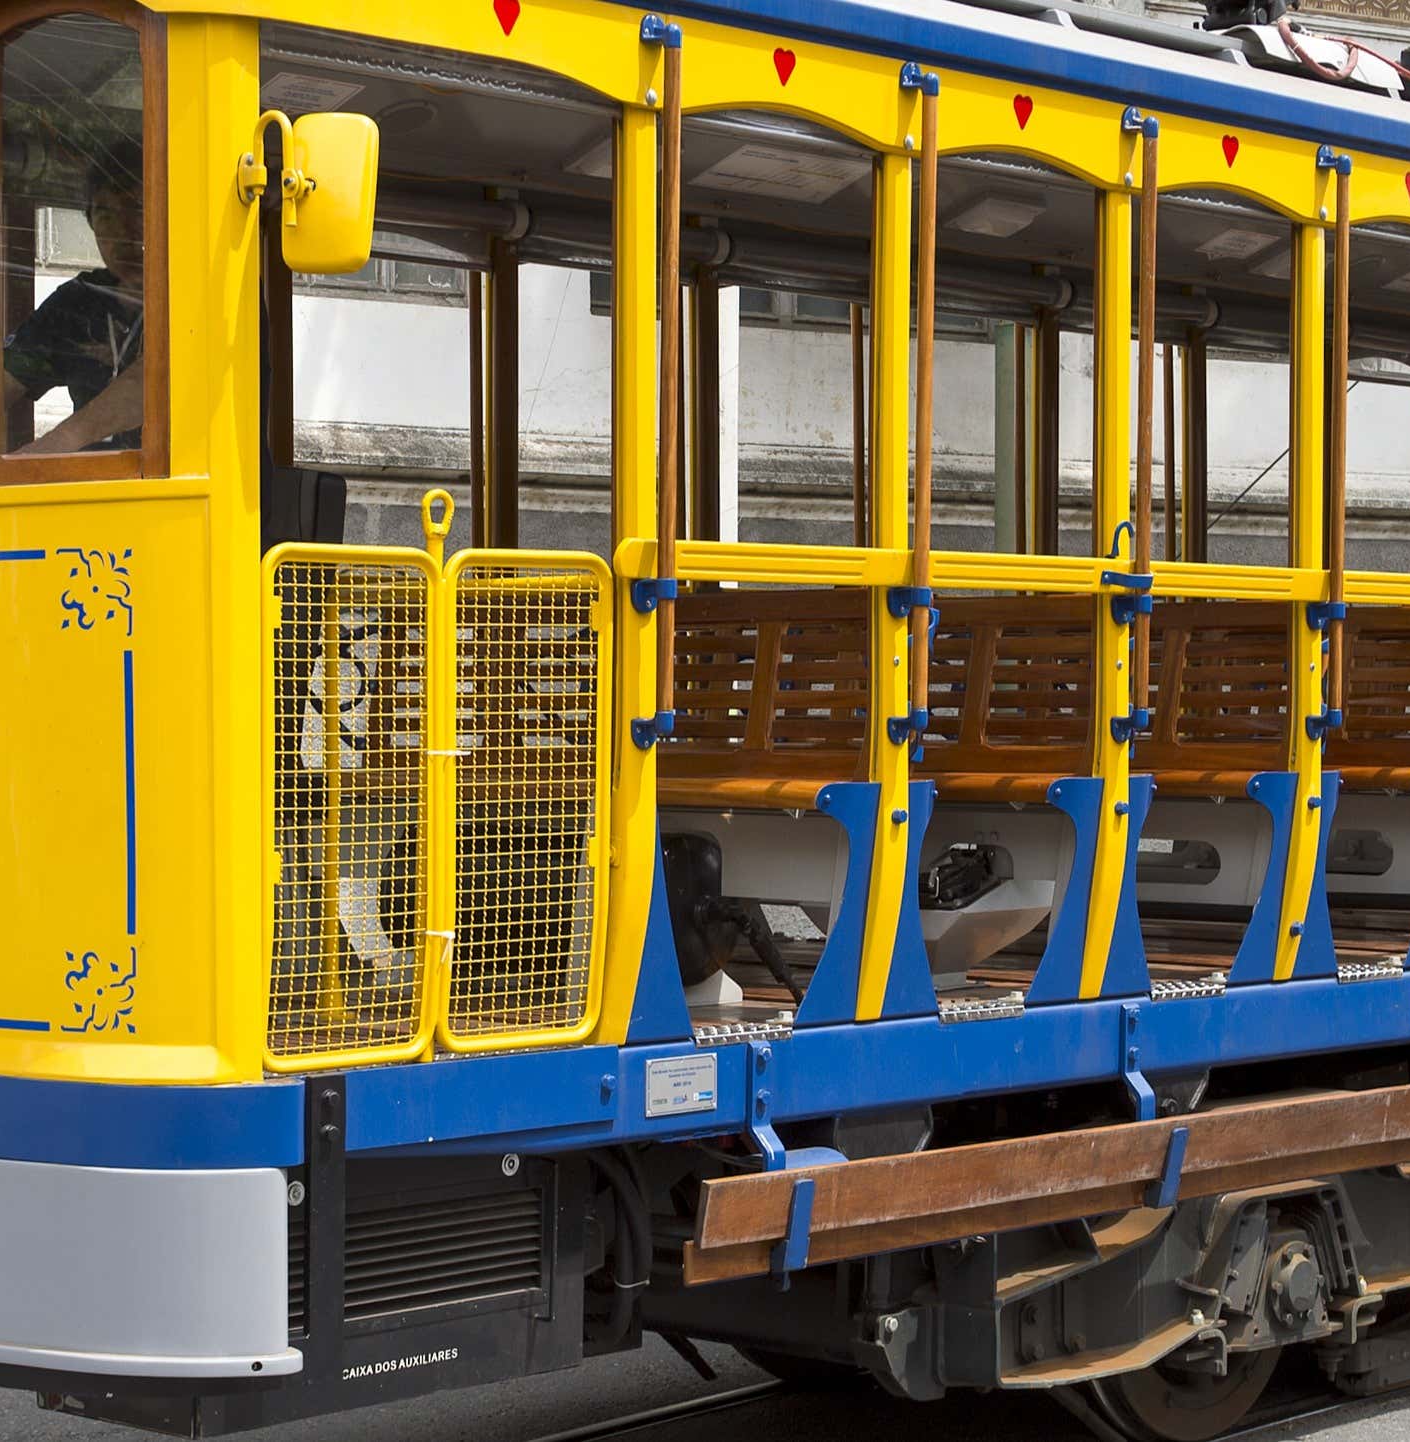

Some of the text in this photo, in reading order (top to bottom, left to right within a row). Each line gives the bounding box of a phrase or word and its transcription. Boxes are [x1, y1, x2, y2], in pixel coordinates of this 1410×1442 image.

[342, 1347, 458, 1380] CAIXA DOS AUXILIARES
